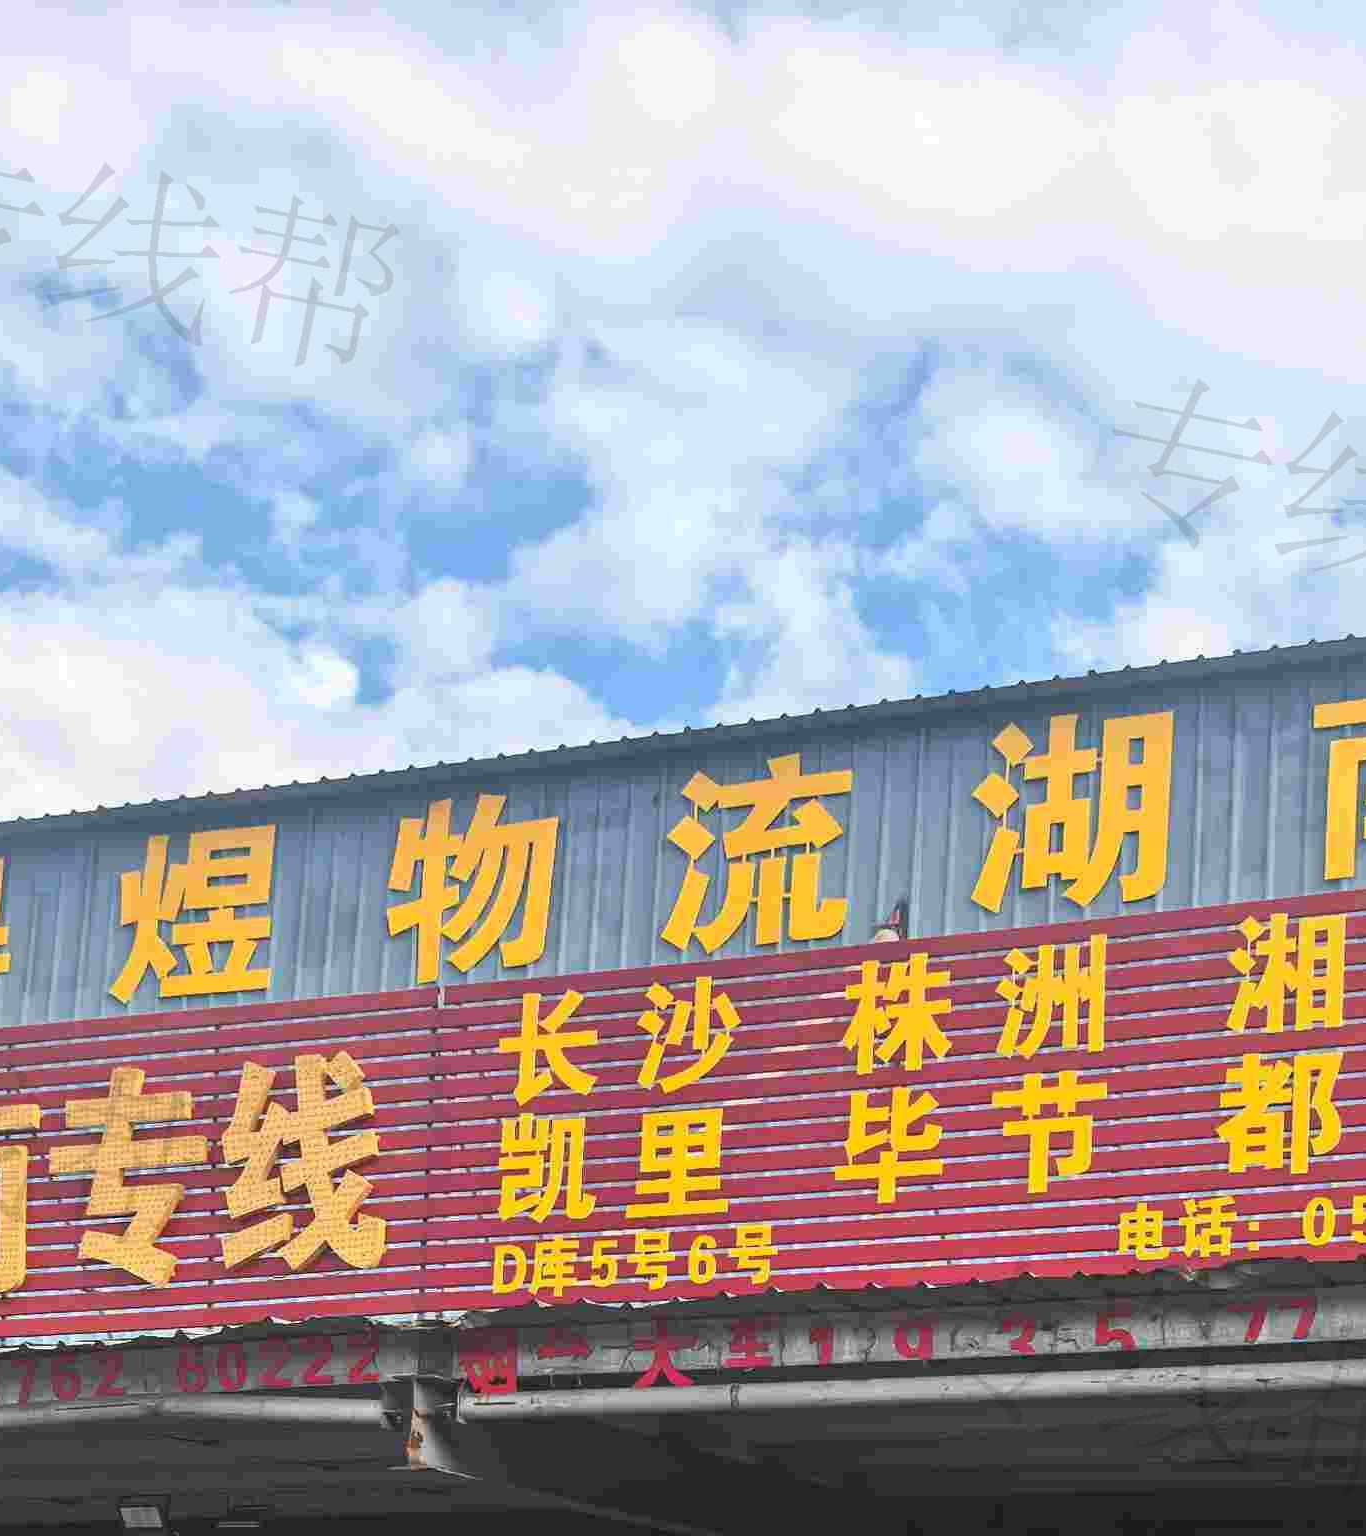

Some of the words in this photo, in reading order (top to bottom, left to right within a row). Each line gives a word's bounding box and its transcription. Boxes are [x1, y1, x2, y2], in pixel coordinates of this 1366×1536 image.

[498, 976, 742, 1106] 长沙
[843, 934, 1109, 1075] 株洲
[497, 1108, 731, 1224] 凯里
[834, 1069, 1109, 1205] 毕节
[491, 1224, 779, 1297] D库5号6号
